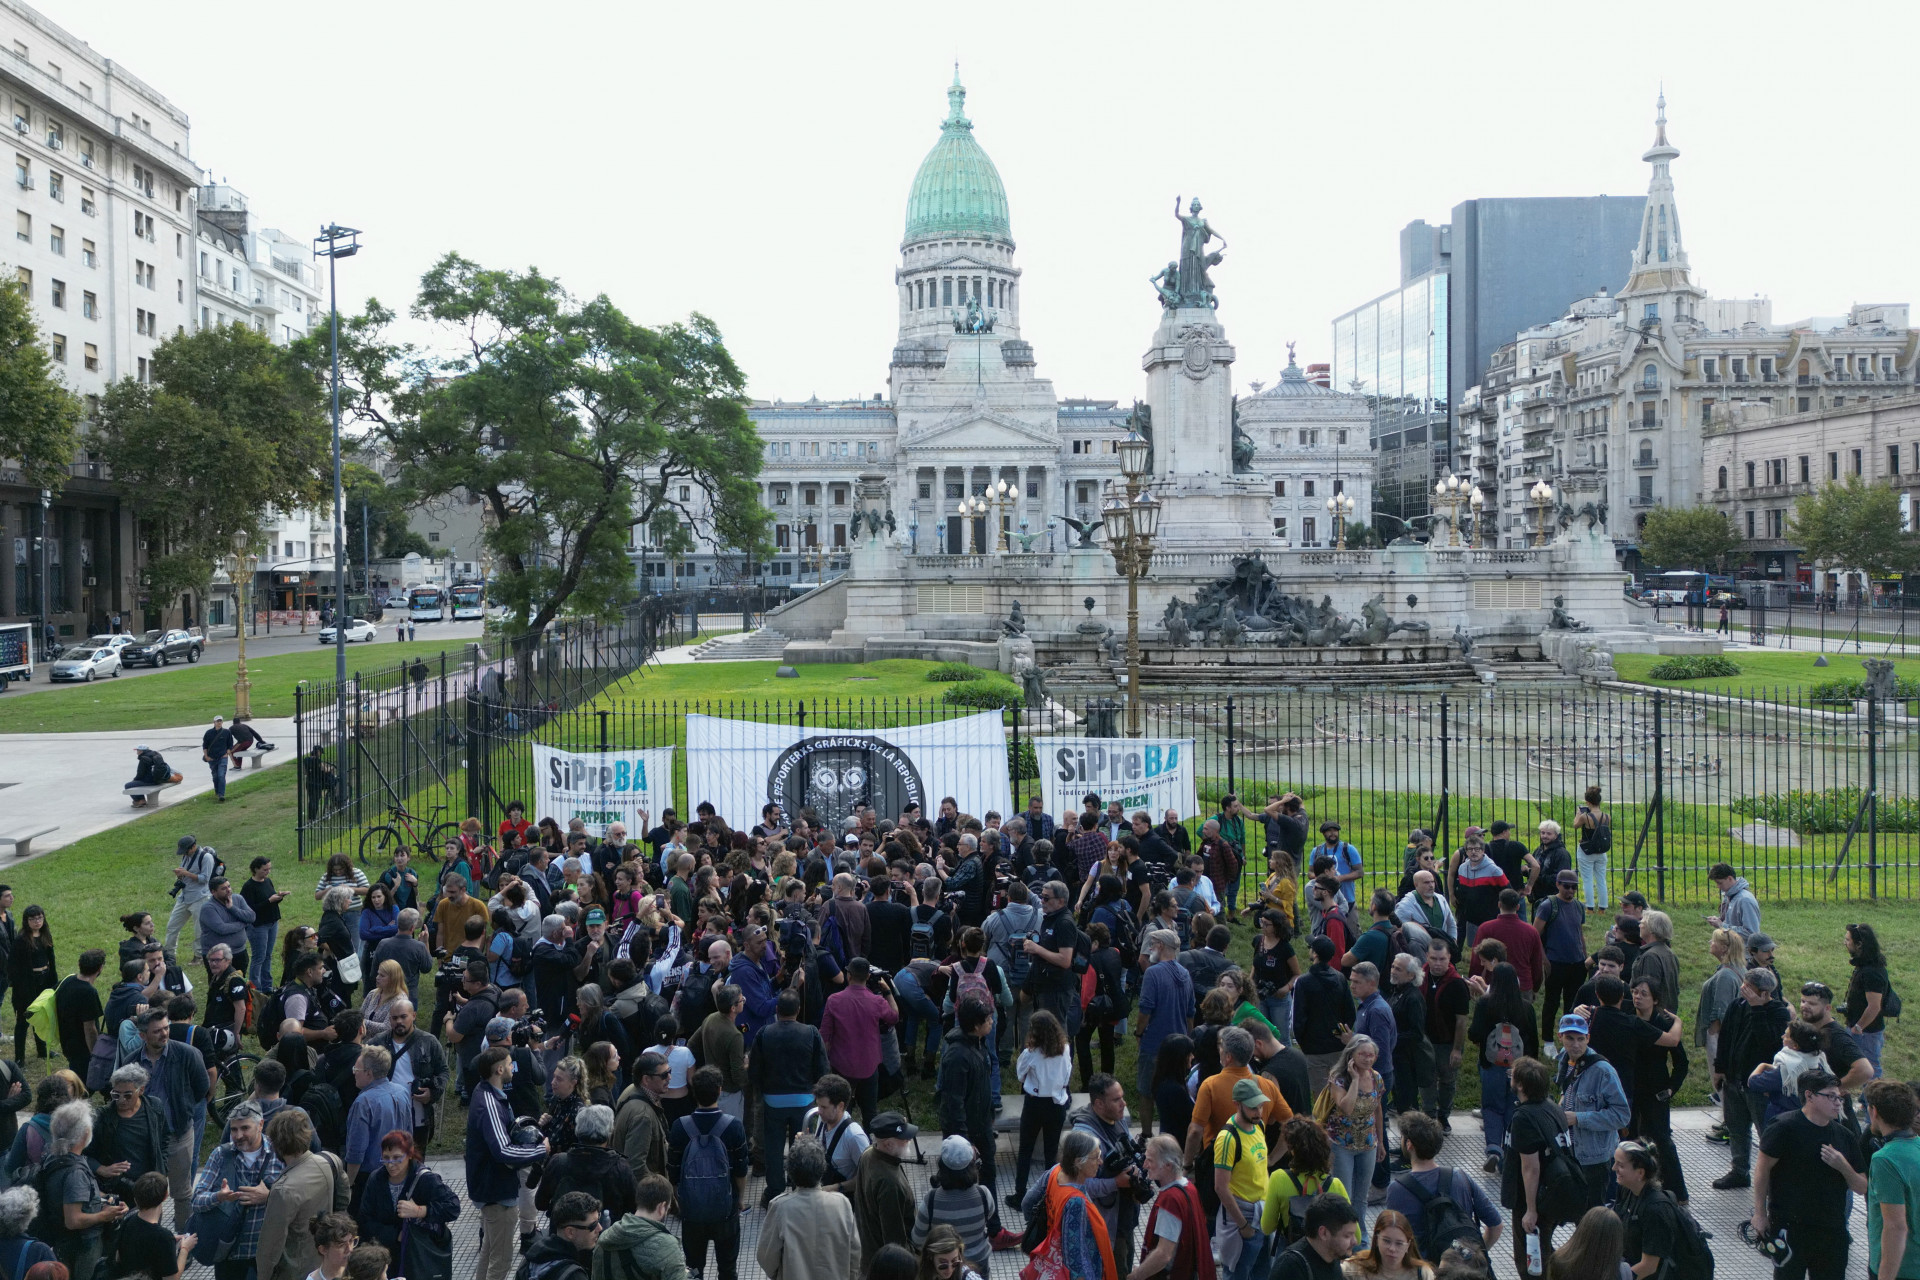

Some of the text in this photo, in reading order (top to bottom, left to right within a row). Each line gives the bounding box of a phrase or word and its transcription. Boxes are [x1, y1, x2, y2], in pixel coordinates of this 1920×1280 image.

[549, 756, 648, 792] SiPreBA
[774, 744, 814, 796] REPORTERXS
[814, 736, 868, 750] GRÁFICXS
[868, 743, 881, 754] DE
[881, 748, 896, 762] LA
[892, 758, 920, 806] REPÚBLIC
[1056, 744, 1179, 782] SiPreBA
